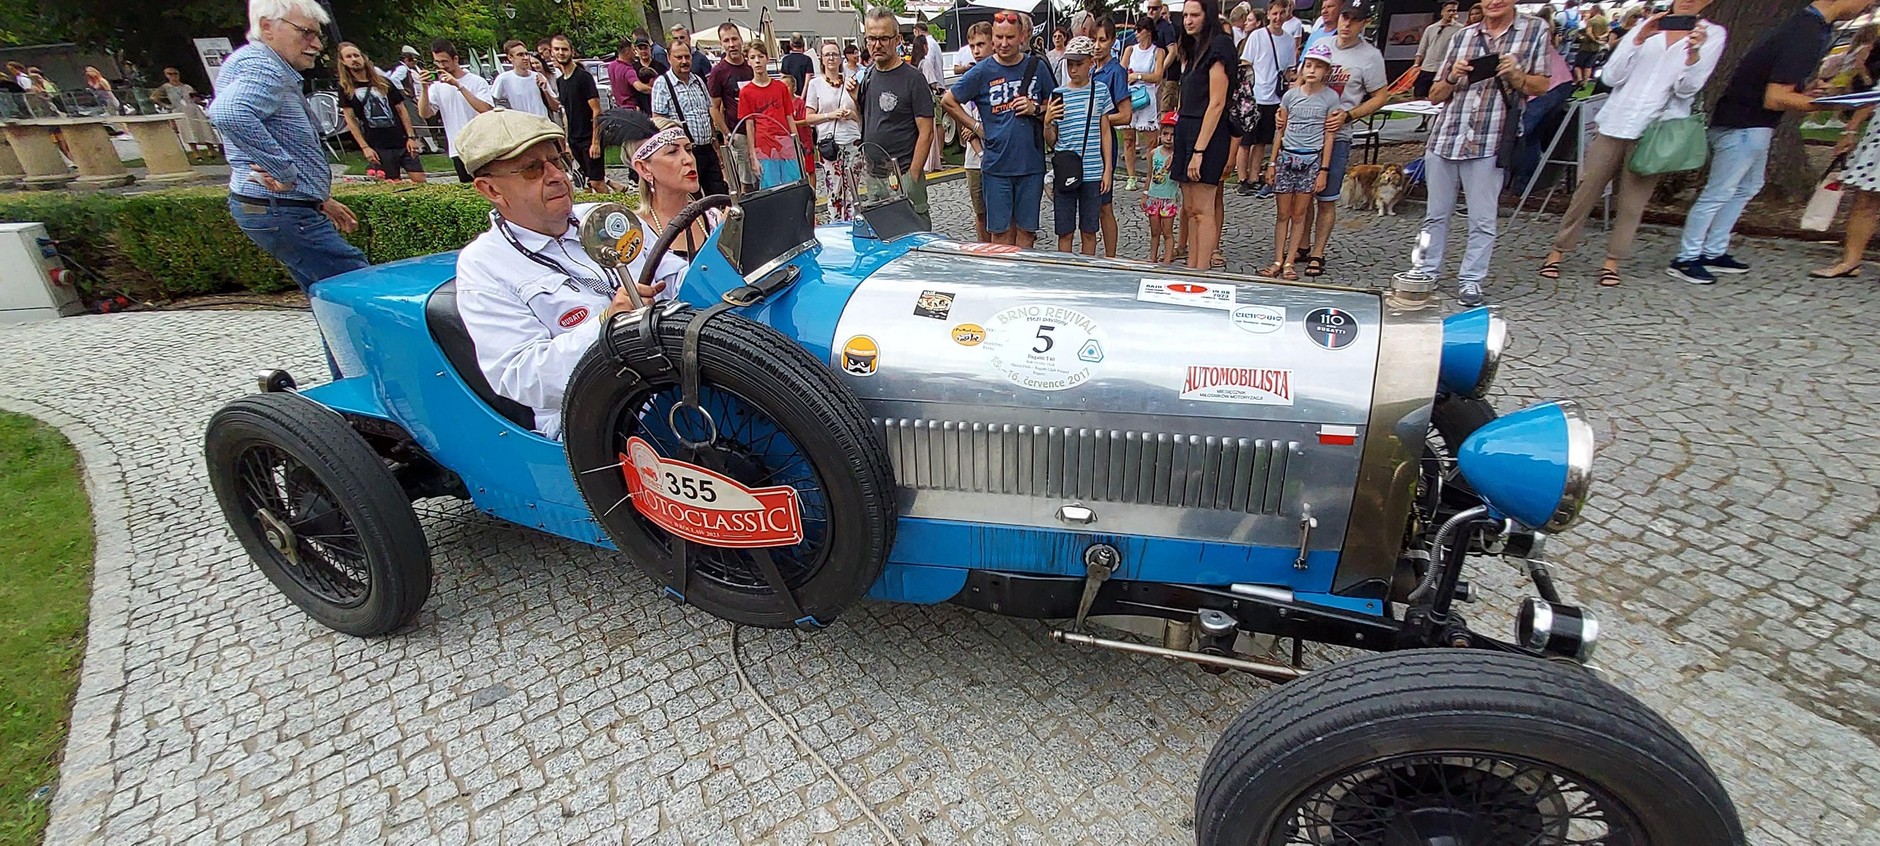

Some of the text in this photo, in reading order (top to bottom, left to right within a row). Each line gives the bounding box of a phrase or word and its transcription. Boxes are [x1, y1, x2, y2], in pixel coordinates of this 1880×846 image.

[561, 310, 586, 326] BUGATTI
[996, 306, 1097, 336] BRNO REVIVAL
[1316, 325, 1347, 335] BUGATTI
[1320, 313, 1345, 326] 110
[1032, 324, 1056, 354] 5
[1023, 376, 1066, 389] července
[1067, 366, 1091, 386] 2017
[1182, 365, 1290, 401] AUTOMOBILISTA
[665, 472, 718, 503] 355
[635, 484, 790, 533] MOTOCLASSIC
